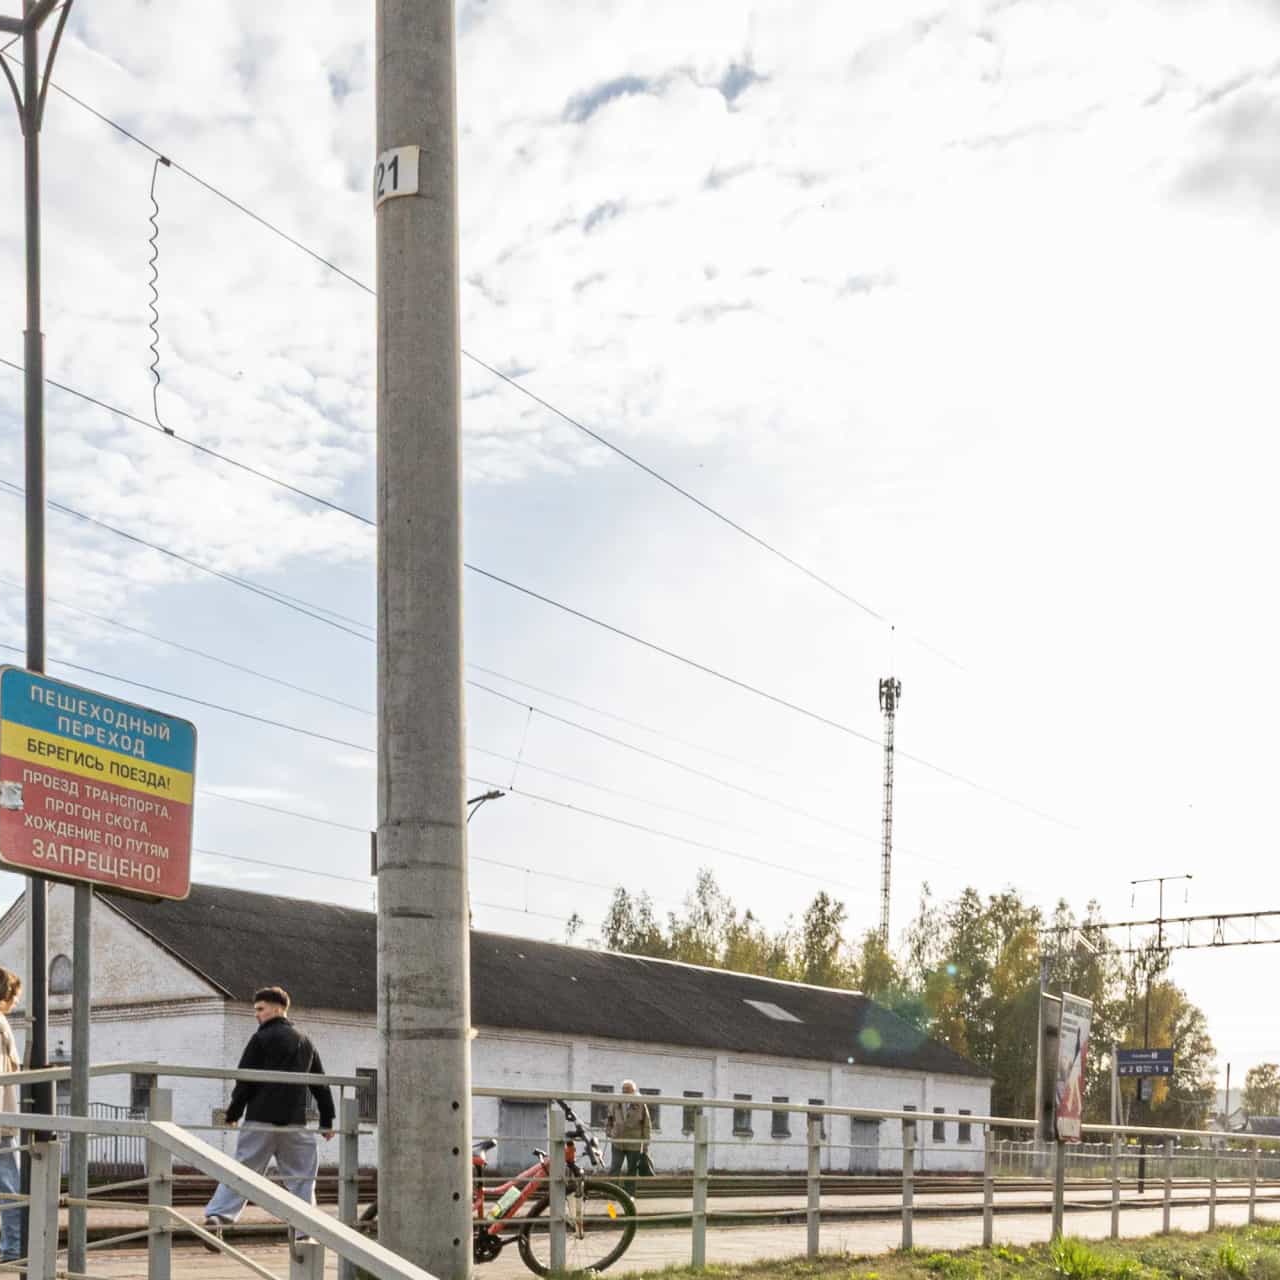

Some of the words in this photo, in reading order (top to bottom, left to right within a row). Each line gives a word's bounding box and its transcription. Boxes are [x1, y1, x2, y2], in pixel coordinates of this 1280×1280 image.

[31, 685, 170, 742] ПЕШЕХОДНЫЙ
[58, 716, 145, 759] ПЕРЕХОД
[27, 738, 104, 772] БЕРЕГИСЬ
[109, 760, 171, 791] ПОЕЗДА!
[23, 769, 79, 798] ПРОЕЗД
[84, 785, 173, 821] ТРАНСПОРТА,
[45, 797, 101, 823] ПРОГОН
[105, 812, 152, 838] СКОТА,
[24, 813, 101, 844] ХОЖДЕНИЕ
[105, 833, 123, 849] ПО
[126, 837, 170, 860] ПУТЯМ
[32, 838, 161, 885] ЗАПРЕЩЕНО!
